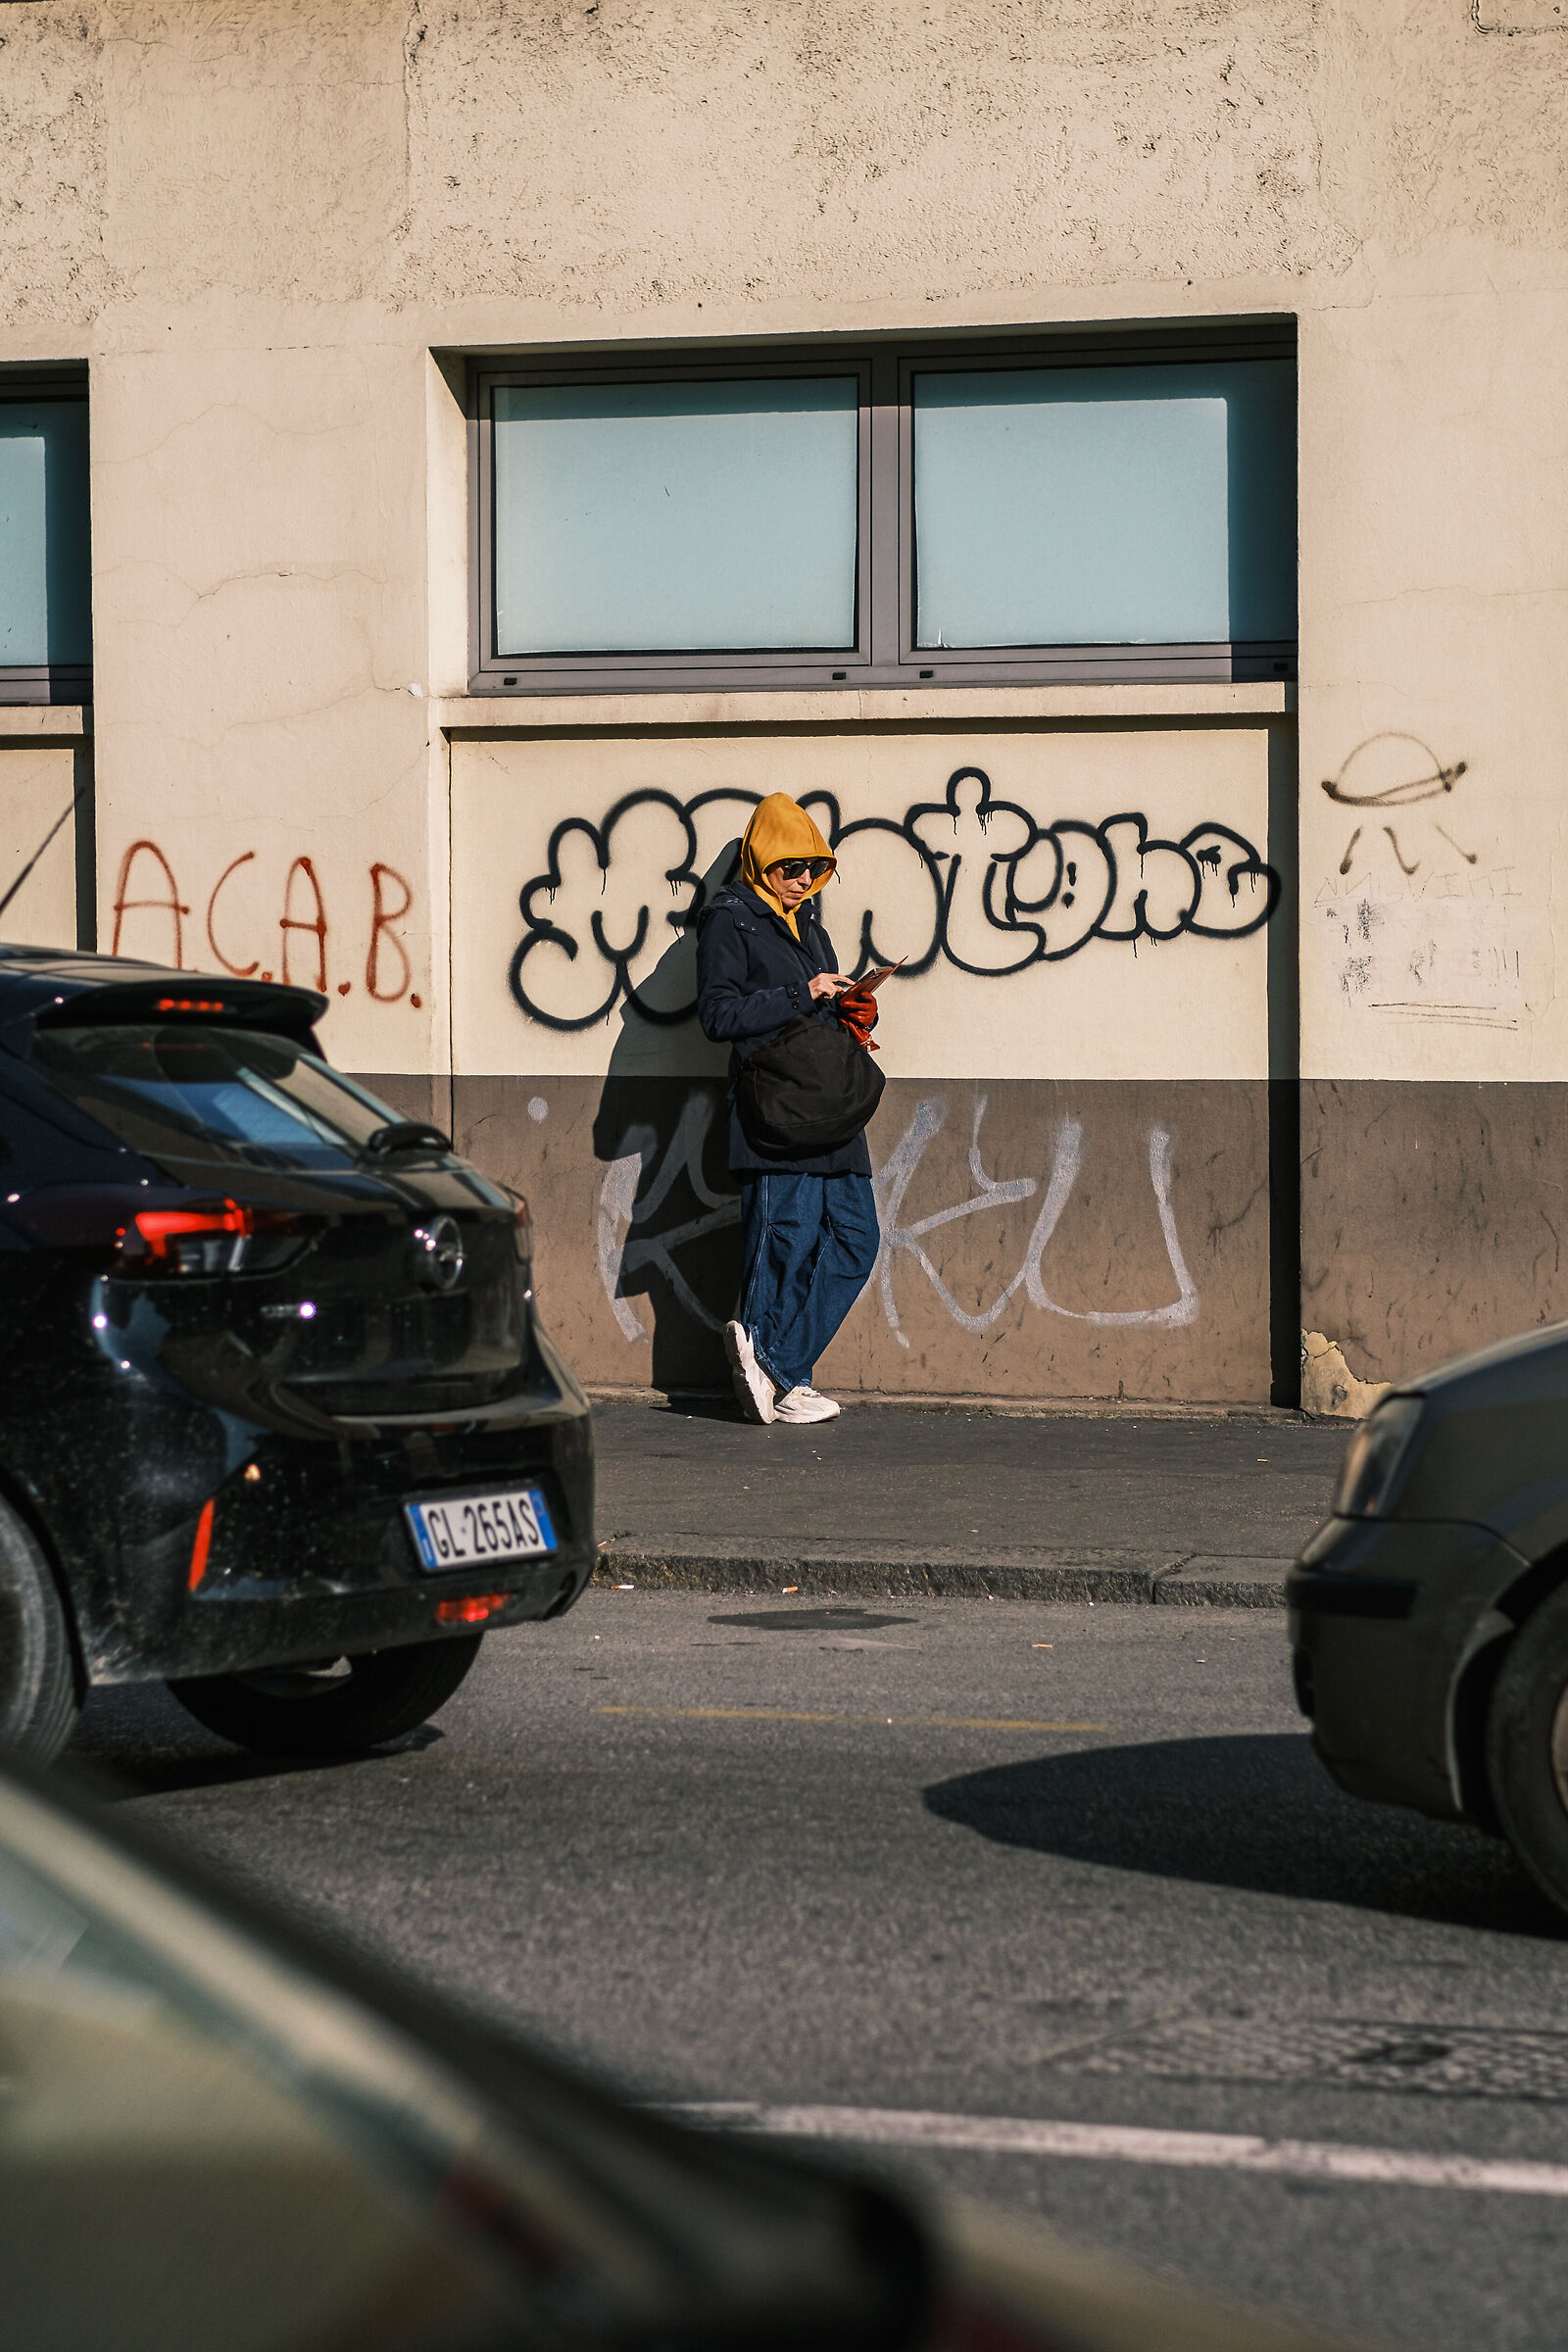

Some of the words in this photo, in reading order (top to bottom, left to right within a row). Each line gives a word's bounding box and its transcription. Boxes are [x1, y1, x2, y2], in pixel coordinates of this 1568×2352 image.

[112, 840, 421, 1008] AC.A.B.
[427, 1507, 466, 1559] GL
[464, 1497, 540, 1554] 265AS
